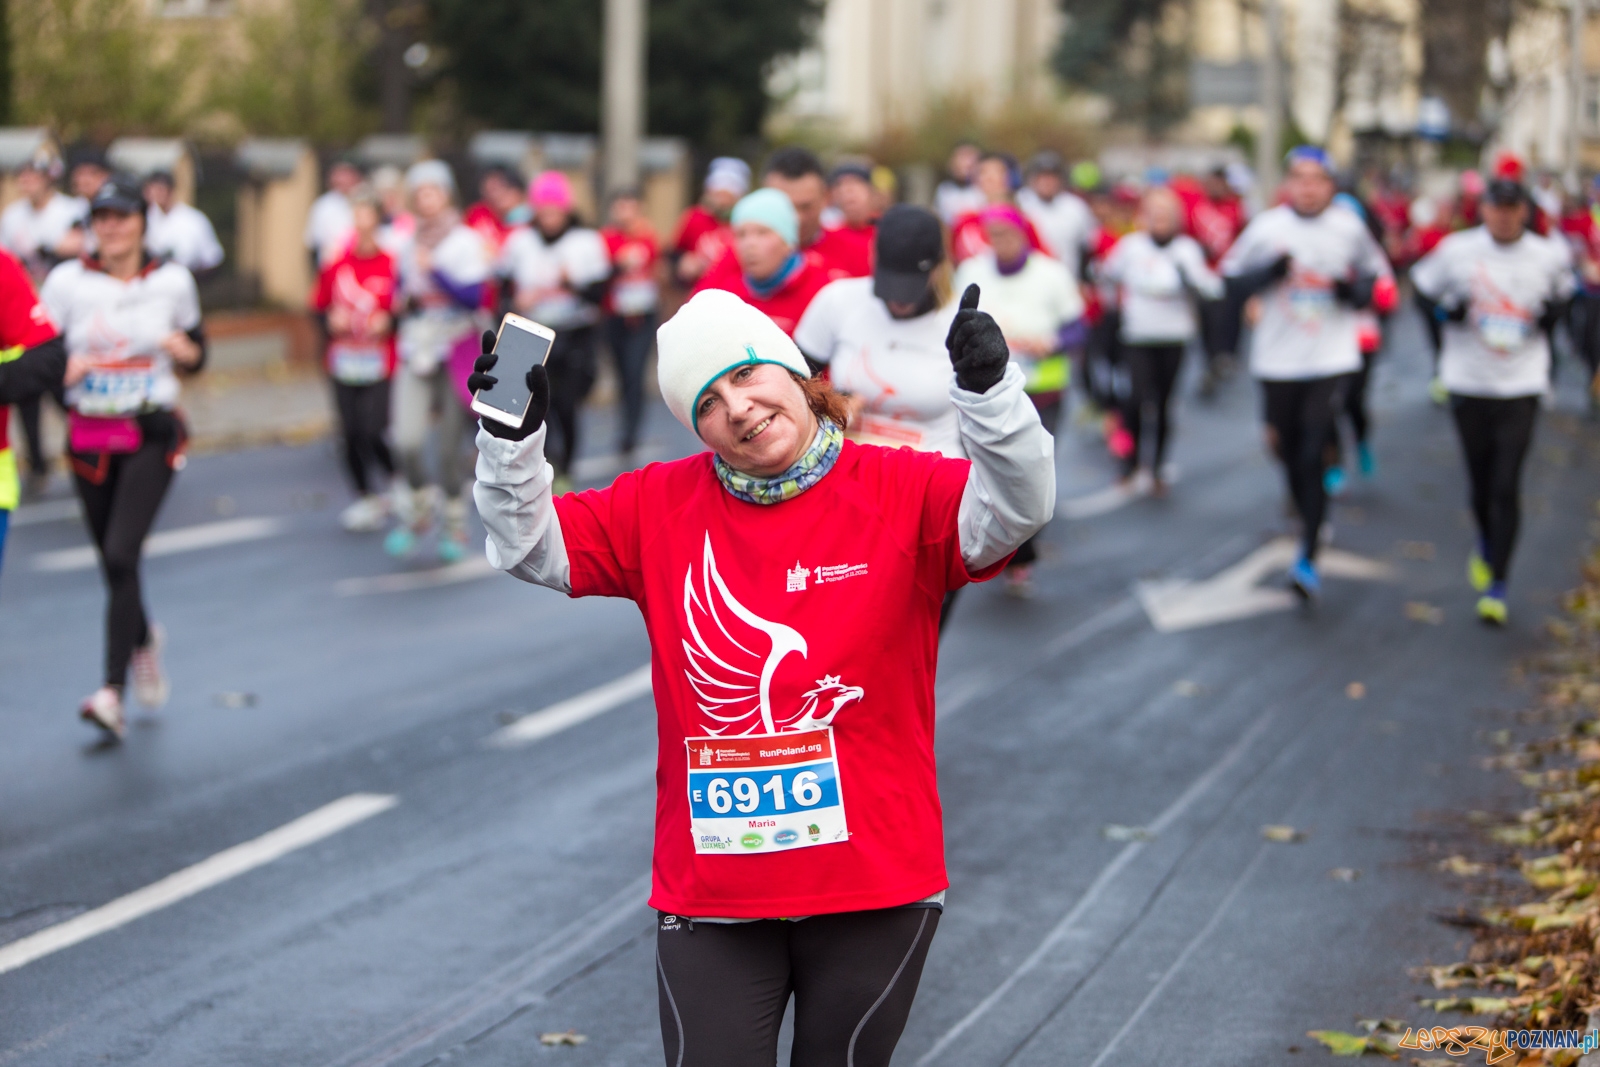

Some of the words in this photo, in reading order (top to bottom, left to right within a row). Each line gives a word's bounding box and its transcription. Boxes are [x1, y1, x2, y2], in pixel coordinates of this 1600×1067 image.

[759, 743, 822, 758] RunPoland.org
[692, 789, 703, 802] E
[707, 770, 822, 814] 6916
[748, 819, 776, 828] Maria
[701, 835, 722, 843] GRUPA
